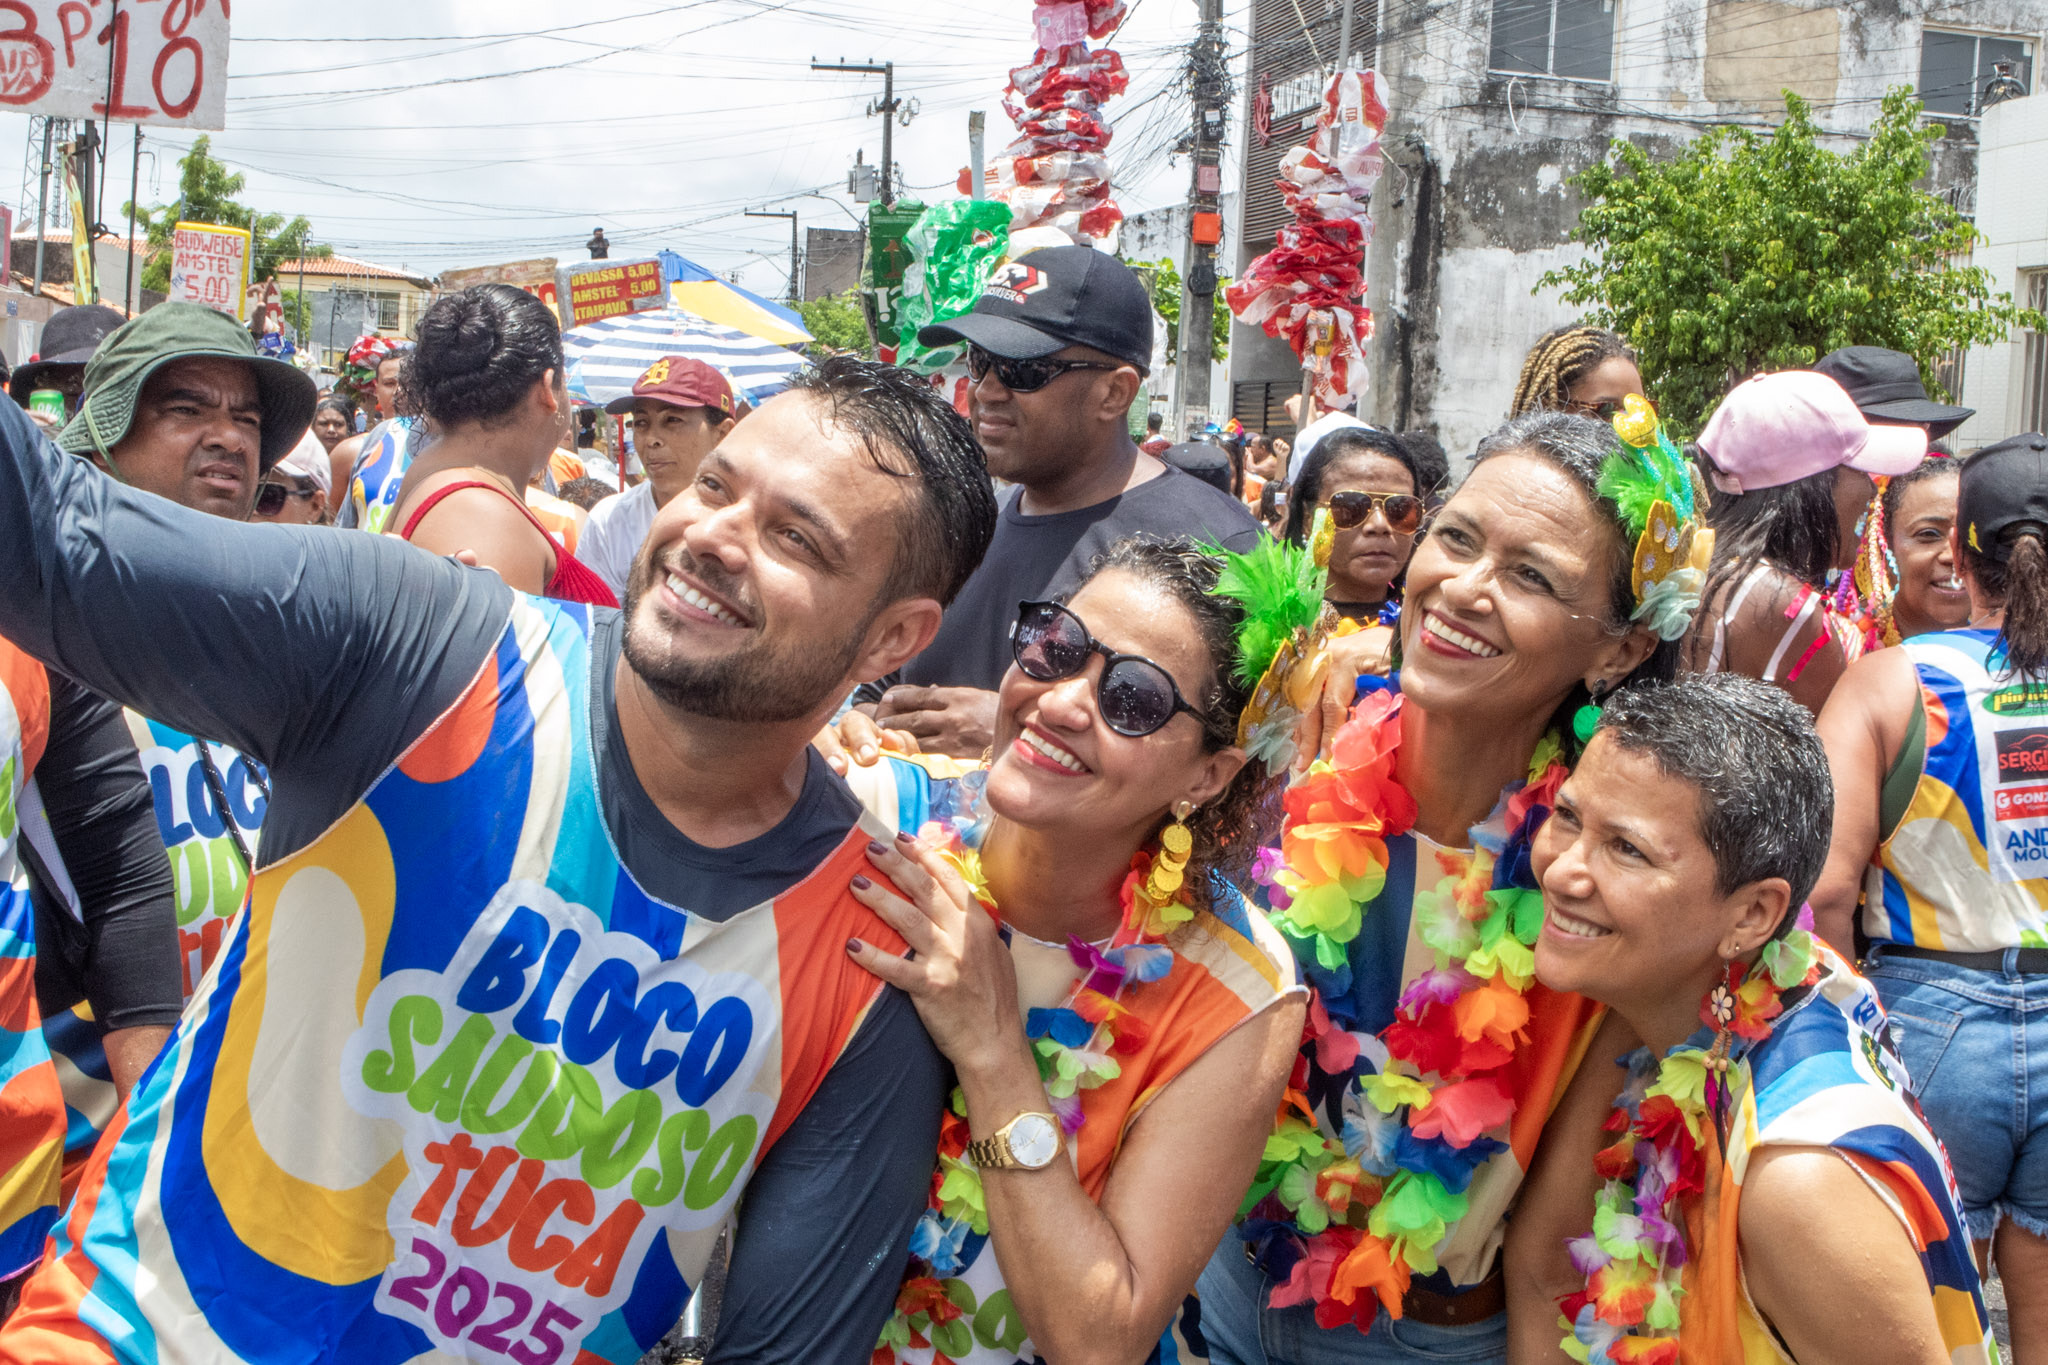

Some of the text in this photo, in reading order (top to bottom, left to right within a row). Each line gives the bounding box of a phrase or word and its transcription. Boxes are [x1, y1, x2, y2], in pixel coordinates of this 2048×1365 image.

[92, 9, 204, 119] 10
[175, 230, 242, 259] BUDWEISE
[176, 252, 235, 275] AMSTEL
[571, 263, 655, 287] DEVASSA 5,00
[184, 274, 230, 304] 5,00
[573, 285, 619, 304] AMSTEL
[630, 279, 657, 295] 5,00
[574, 300, 628, 321] ITAIPAVA
[456, 905, 753, 1107] BLOCO
[361, 995, 758, 1211] SAUDOSO
[411, 1132, 646, 1297] TUCA
[388, 1237, 582, 1365] 2025
